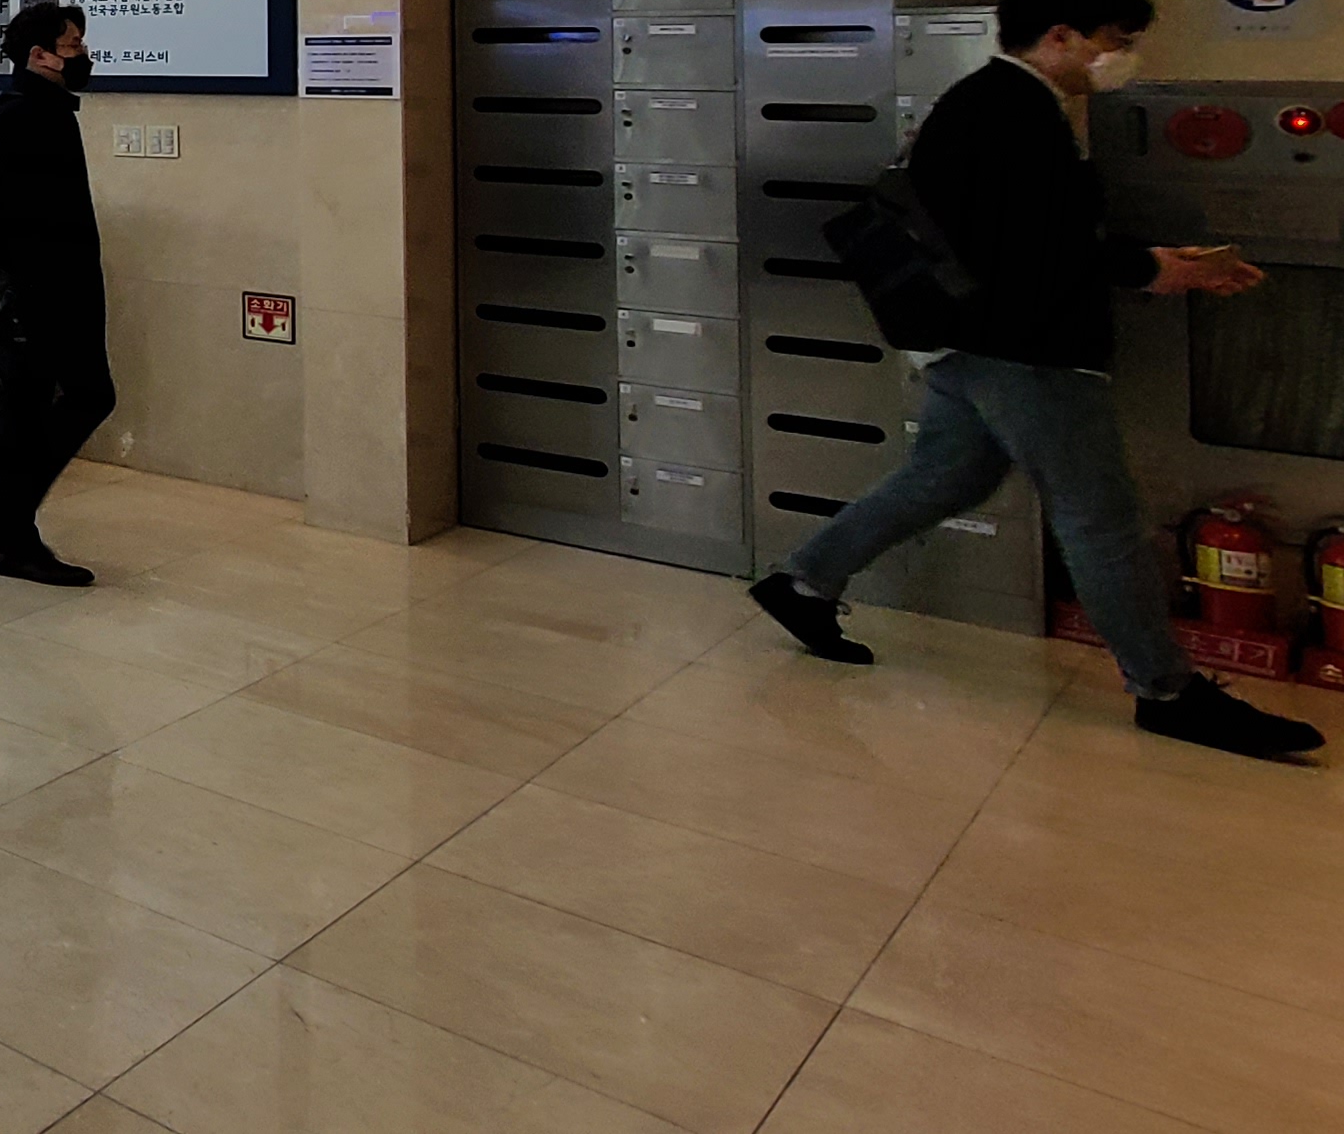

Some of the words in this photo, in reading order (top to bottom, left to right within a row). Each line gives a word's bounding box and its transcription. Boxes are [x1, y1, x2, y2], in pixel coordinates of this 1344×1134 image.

[88, 2, 185, 17] 전국공무원노동조합
[121, 50, 169, 64] 프리스비
[250, 298, 288, 313] 소화기
